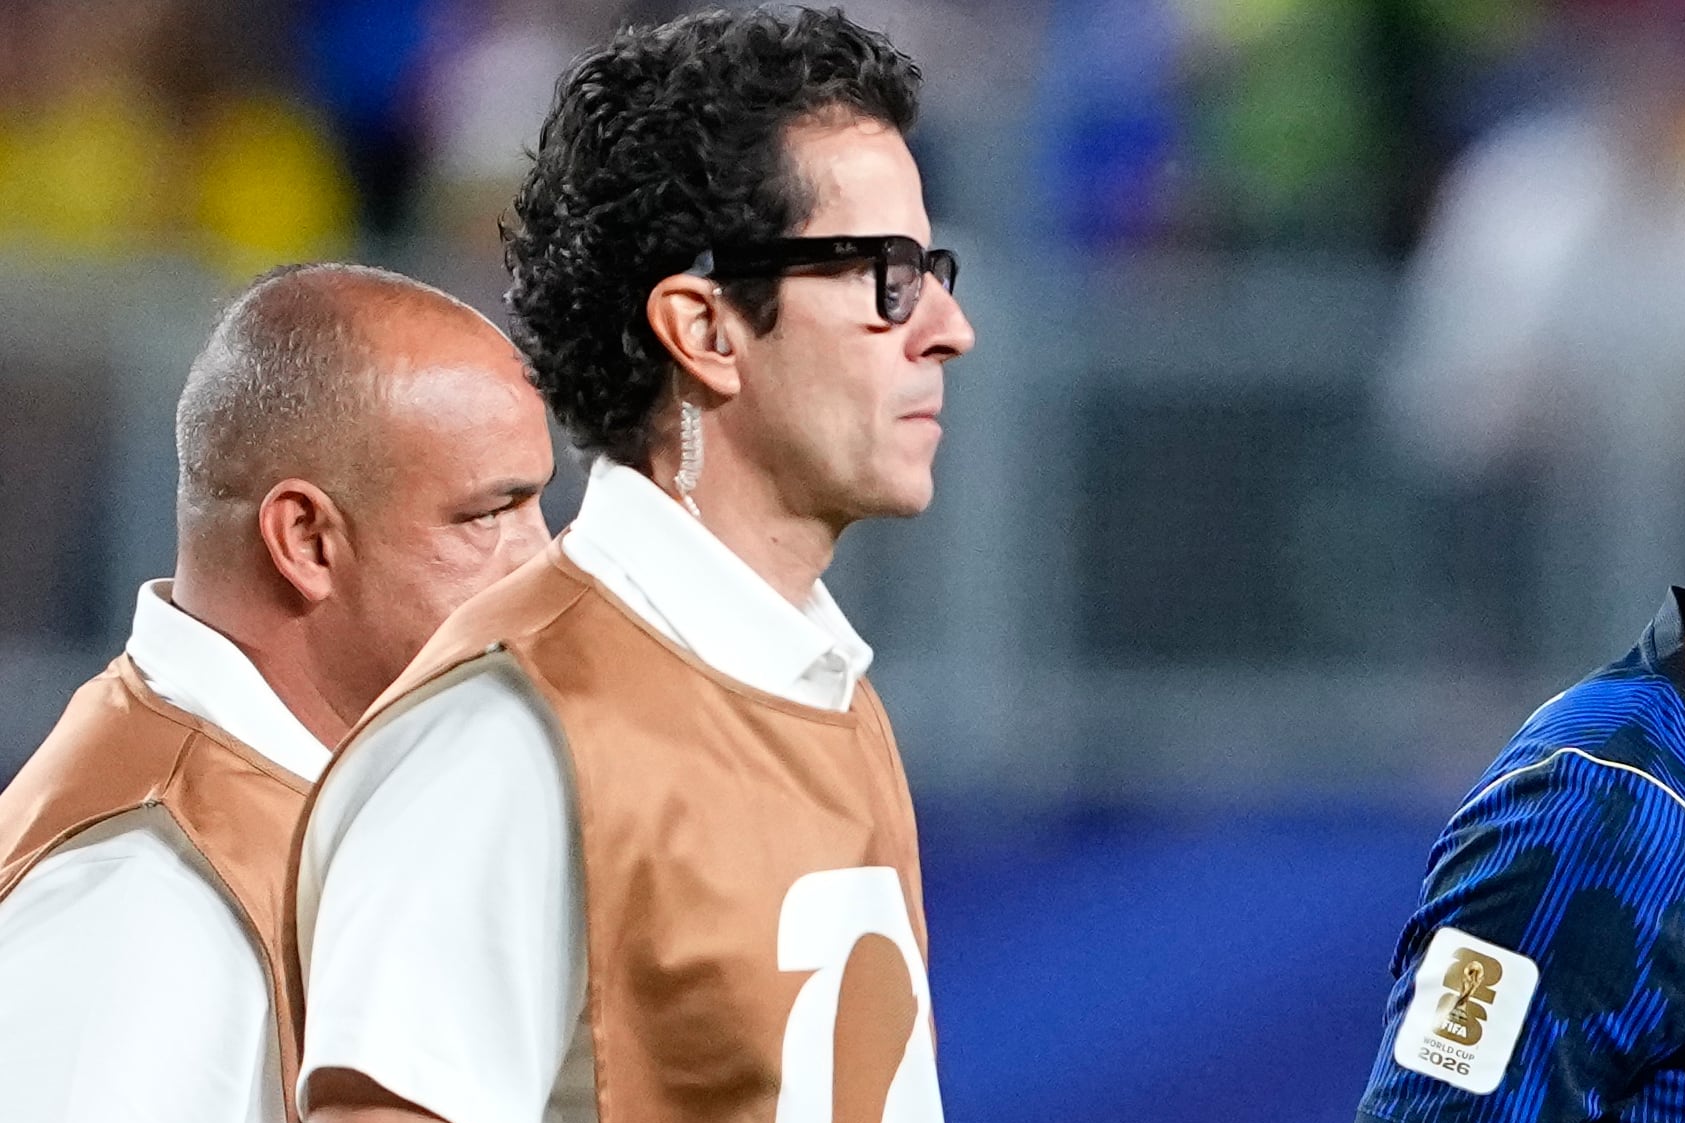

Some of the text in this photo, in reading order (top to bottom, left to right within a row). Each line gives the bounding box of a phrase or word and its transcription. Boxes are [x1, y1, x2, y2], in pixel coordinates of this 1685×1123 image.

[1417, 1046, 1471, 1076] 2026
[1423, 1036, 1476, 1061] WORLD CUP
